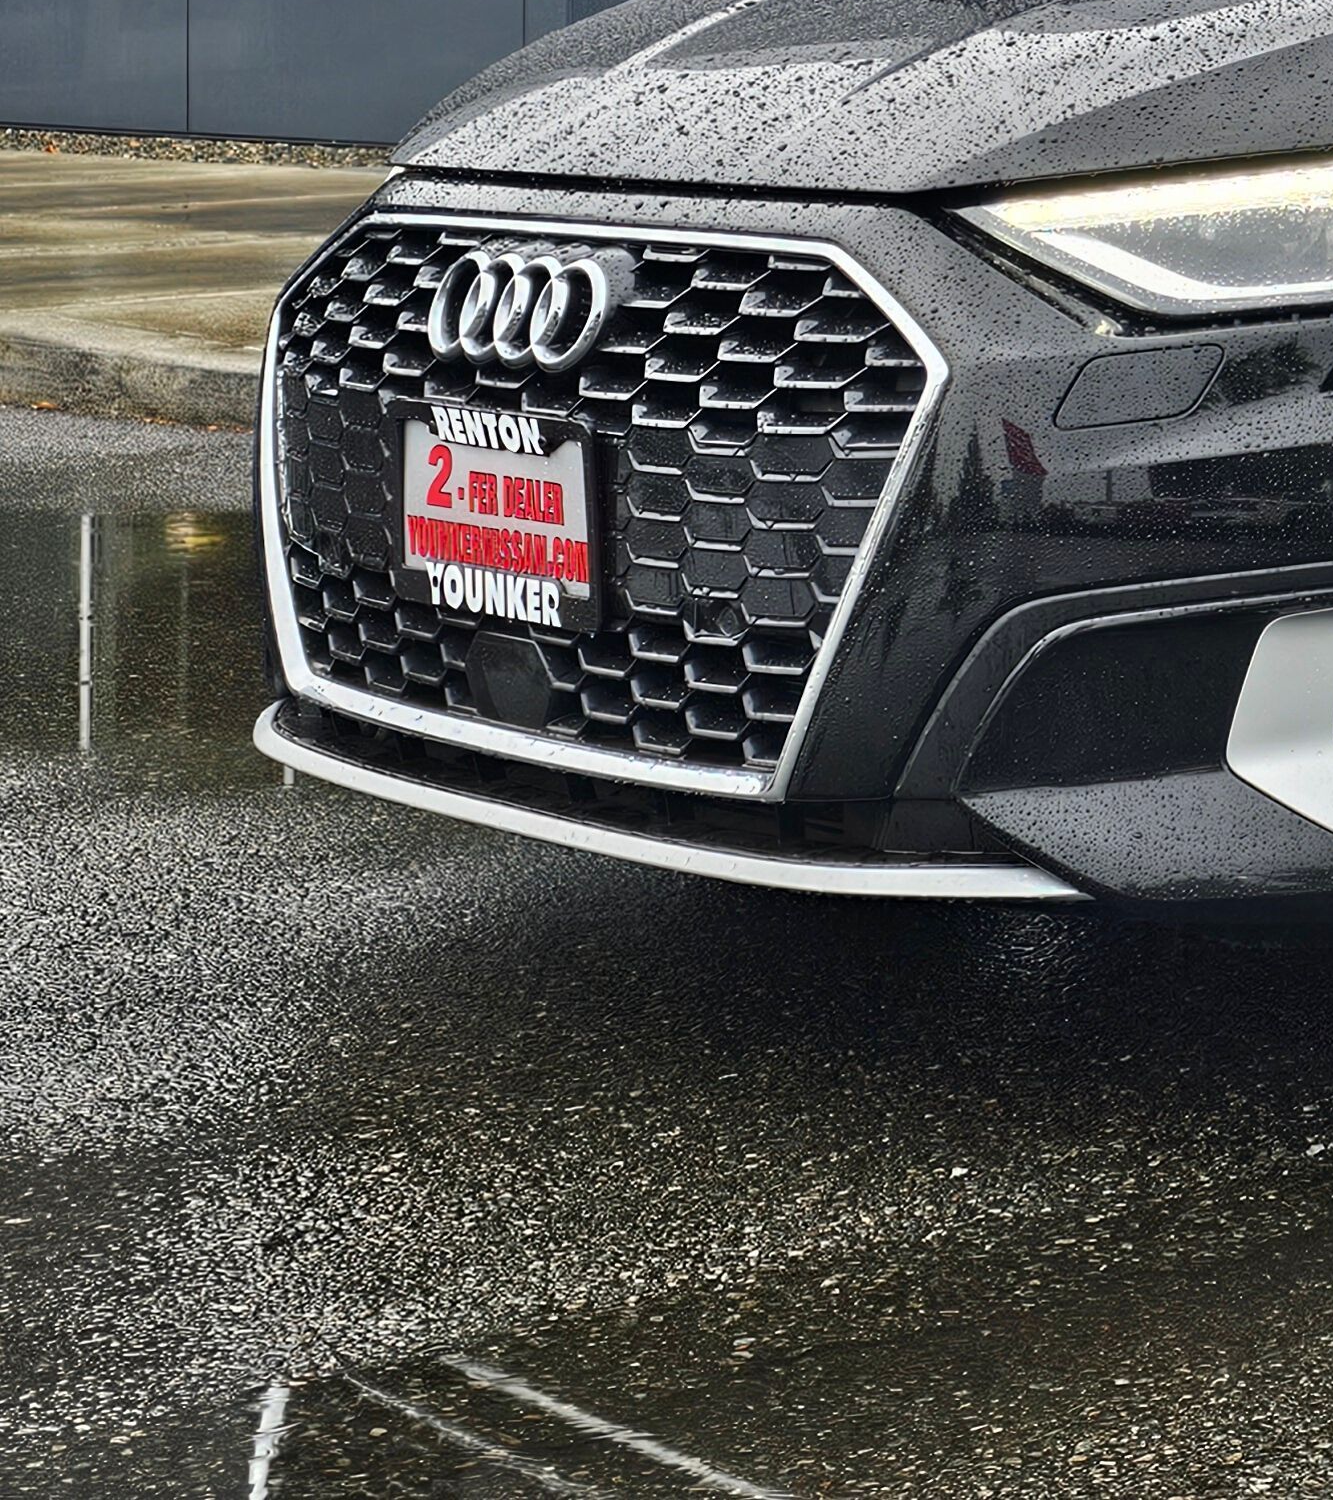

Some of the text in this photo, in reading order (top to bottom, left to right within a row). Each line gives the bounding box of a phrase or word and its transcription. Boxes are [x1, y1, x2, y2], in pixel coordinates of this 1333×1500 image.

[431, 405, 545, 455] RENTON
[503, 476, 565, 526] DEALER
[407, 514, 590, 583] YOUNKERNISSAN.COM
[425, 561, 562, 628] YOUNKER
